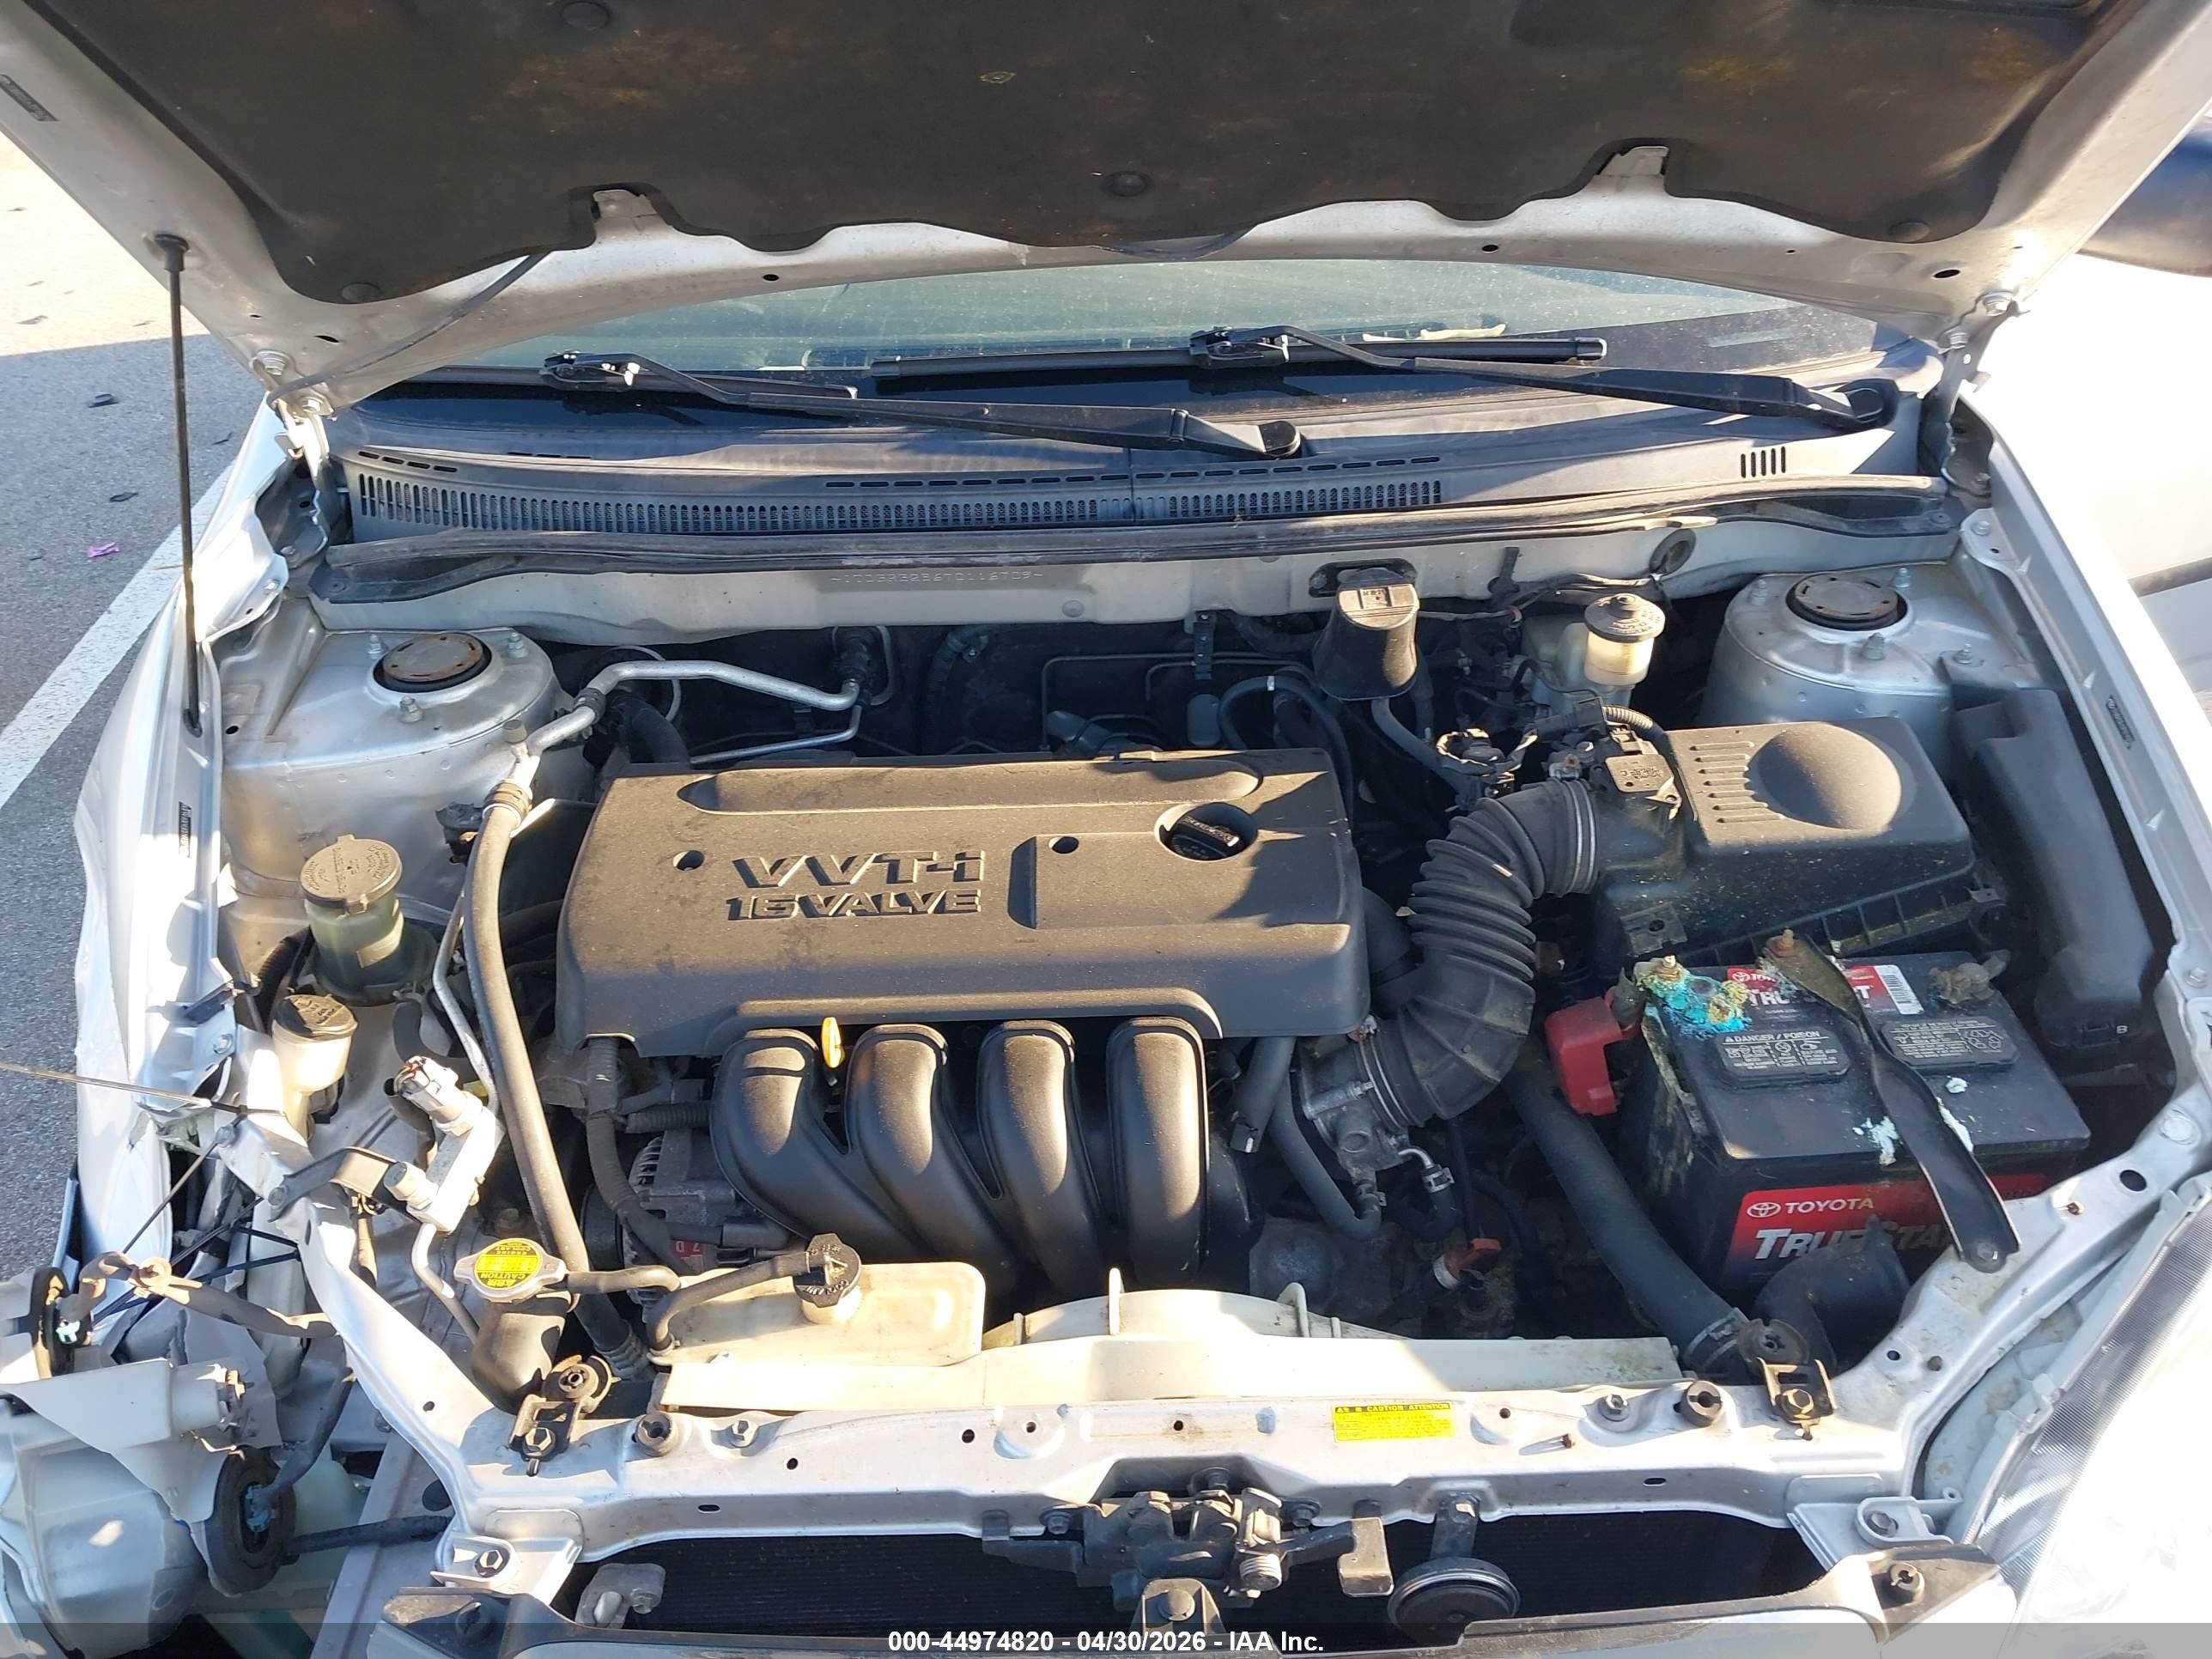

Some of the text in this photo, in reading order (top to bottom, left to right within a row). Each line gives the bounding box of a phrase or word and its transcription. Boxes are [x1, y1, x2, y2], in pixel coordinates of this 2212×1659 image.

[1735, 1034, 1775, 1042] DANGER
[1784, 1030, 1820, 1040] POISON
[1785, 1198, 1874, 1214] TOYOTA
